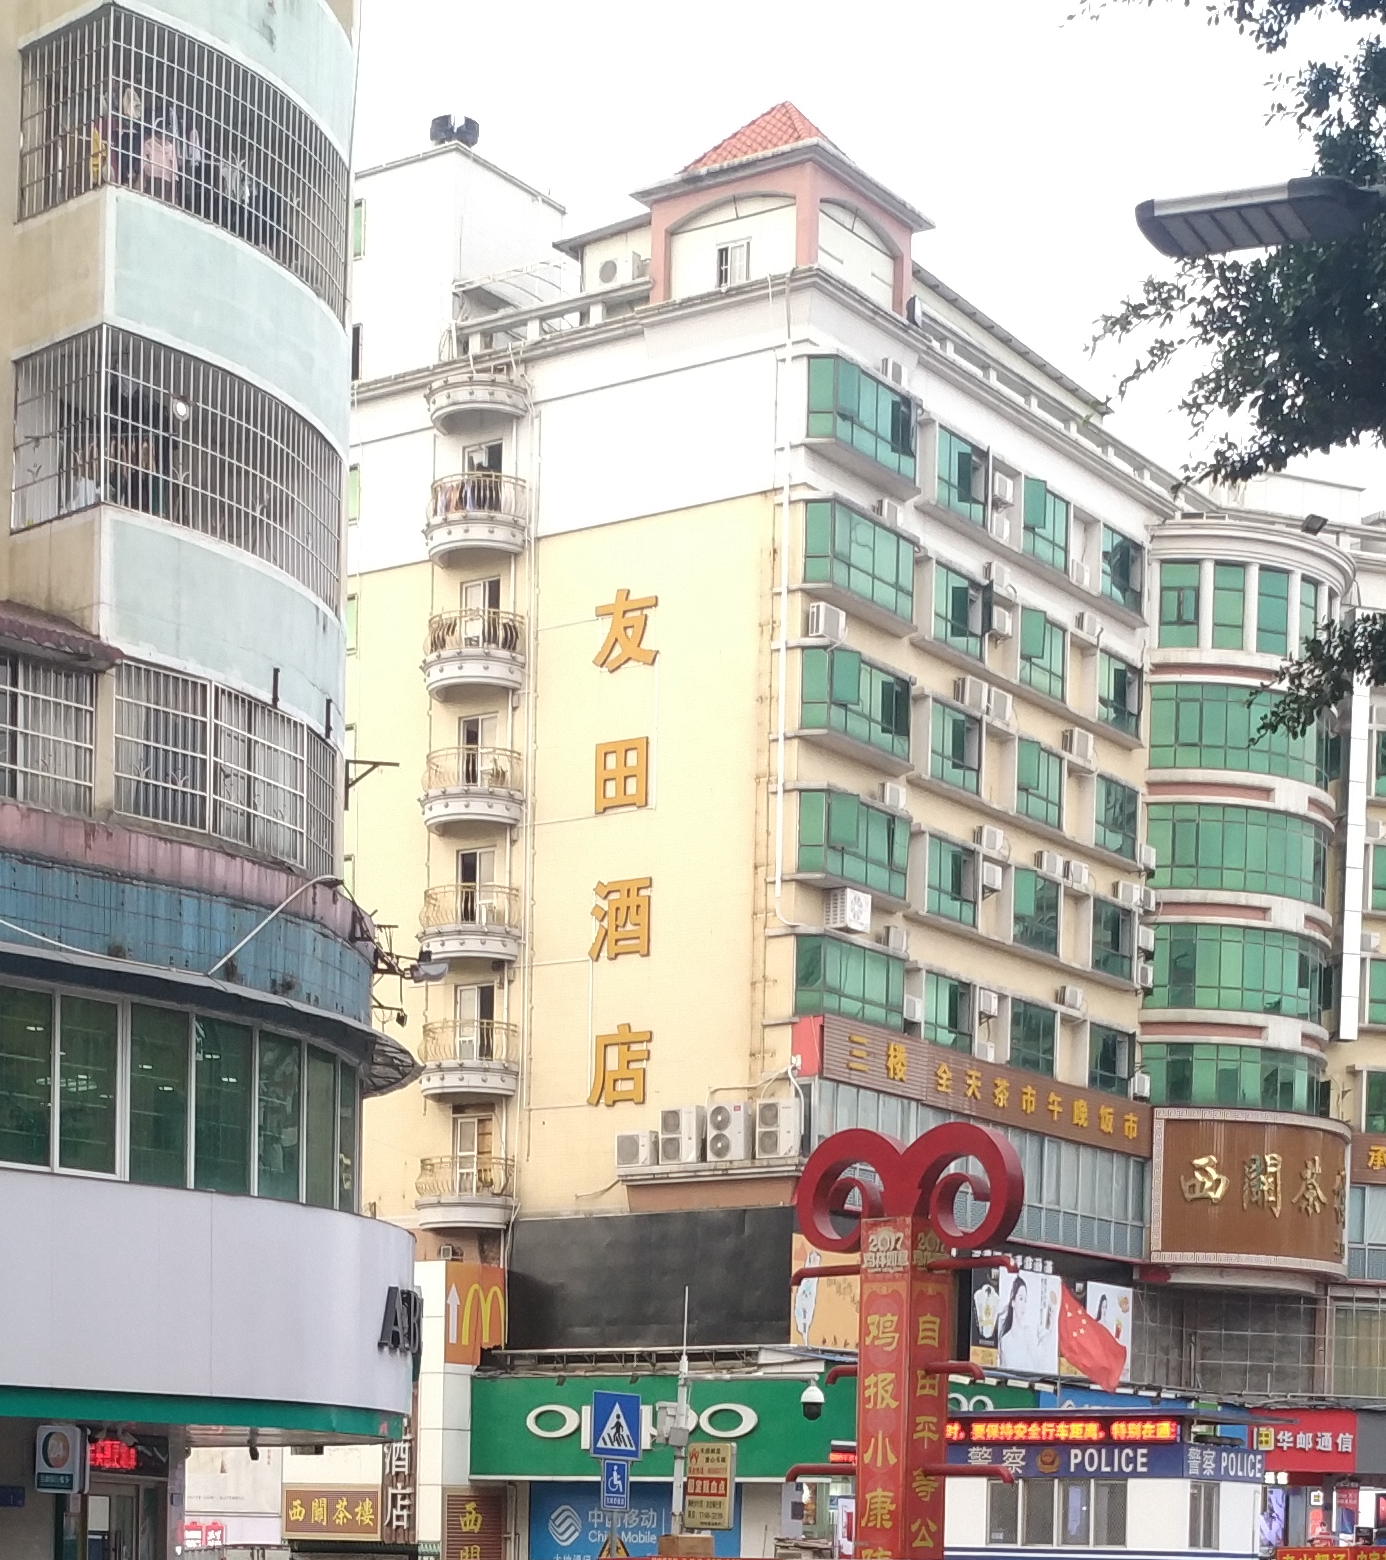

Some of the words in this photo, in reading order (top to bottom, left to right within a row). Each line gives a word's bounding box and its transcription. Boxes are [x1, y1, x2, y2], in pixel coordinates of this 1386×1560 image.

[587, 588, 659, 1108] 友田酒店
[847, 1035, 908, 1083] 三楼
[934, 1062, 1139, 1141] 全天茶市午晚饭市
[869, 1231, 904, 1252] 2017
[1277, 1430, 1354, 1453] 华邮通信
[967, 1447, 1026, 1475] 警察
[1070, 1448, 1148, 1473] POLICE
[1187, 1447, 1216, 1477] 警察
[1221, 1450, 1262, 1479] POLICE
[288, 1497, 375, 1527] 西關茶樓
[621, 1530, 657, 1545] Mobile
